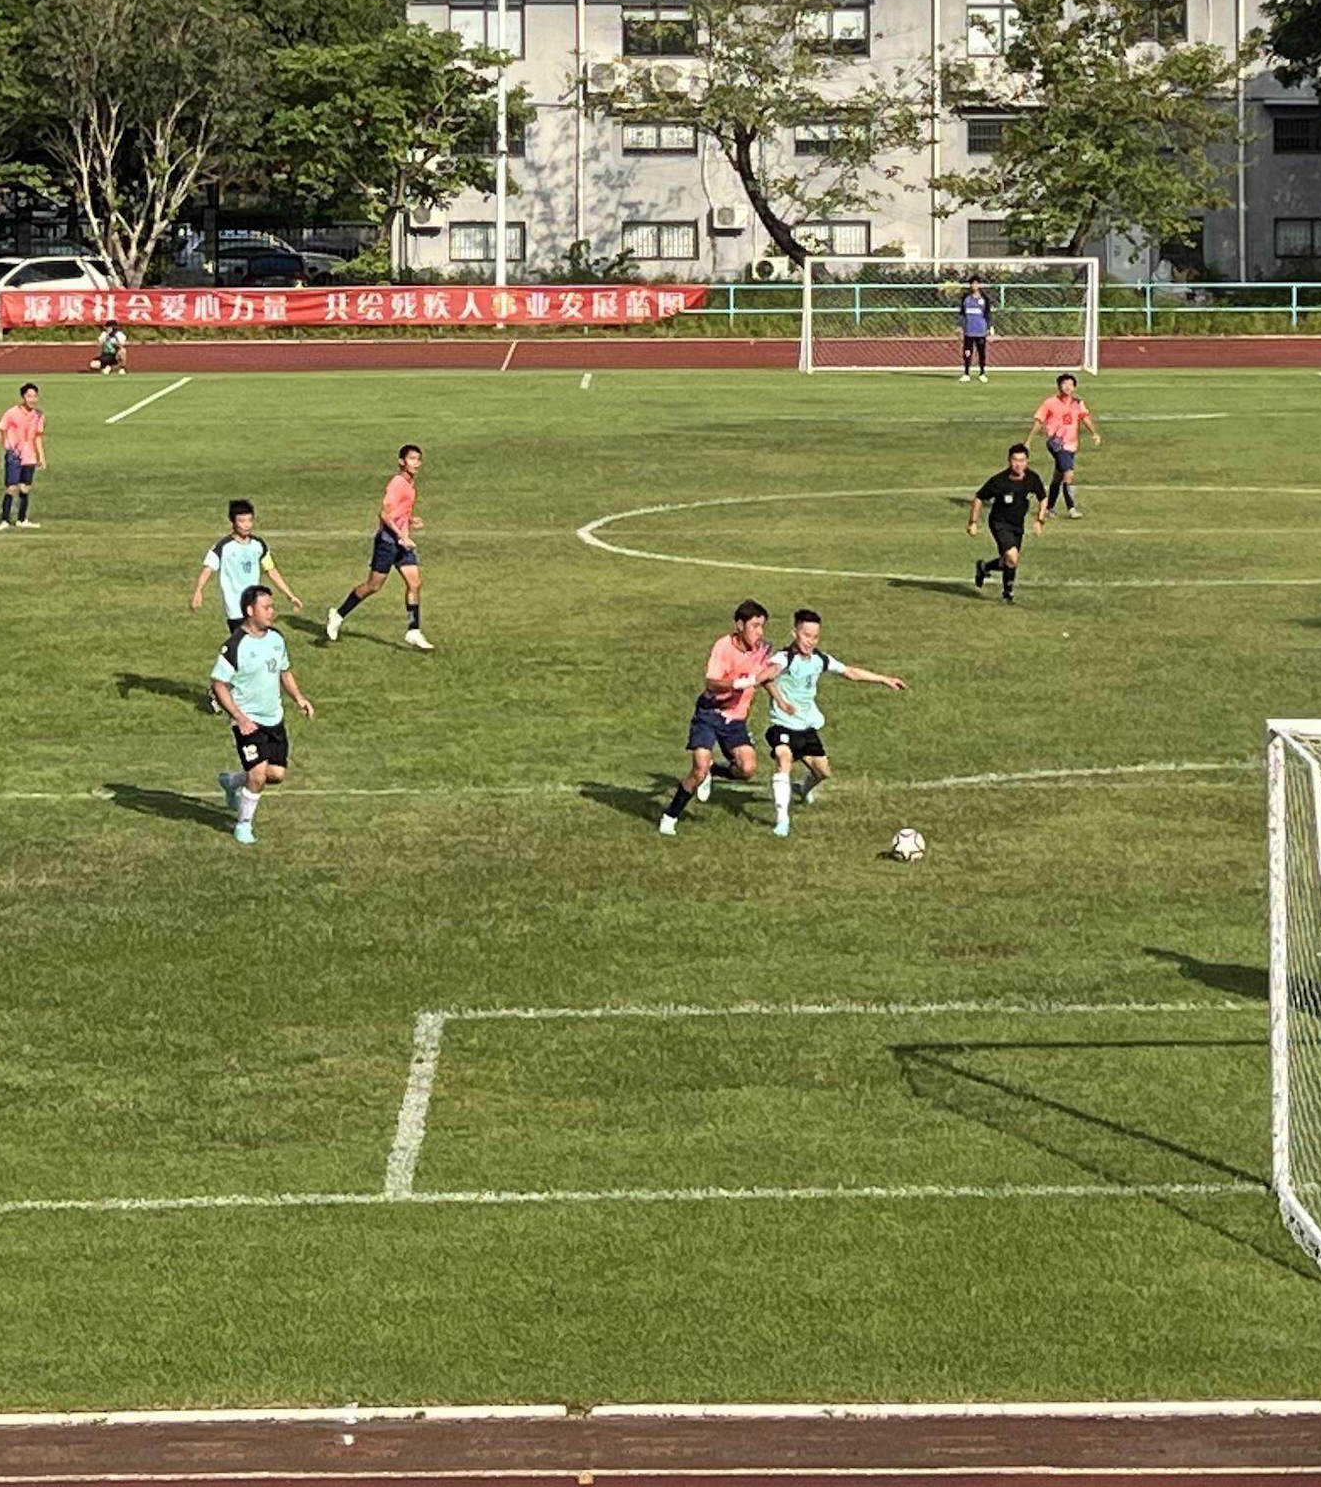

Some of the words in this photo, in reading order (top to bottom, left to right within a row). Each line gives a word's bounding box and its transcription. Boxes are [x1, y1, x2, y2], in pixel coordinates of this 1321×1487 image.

[23, 293, 287, 322] 凝聚社会爱心力量
[324, 291, 685, 320] 共绘残疾人事业发展蓝图
